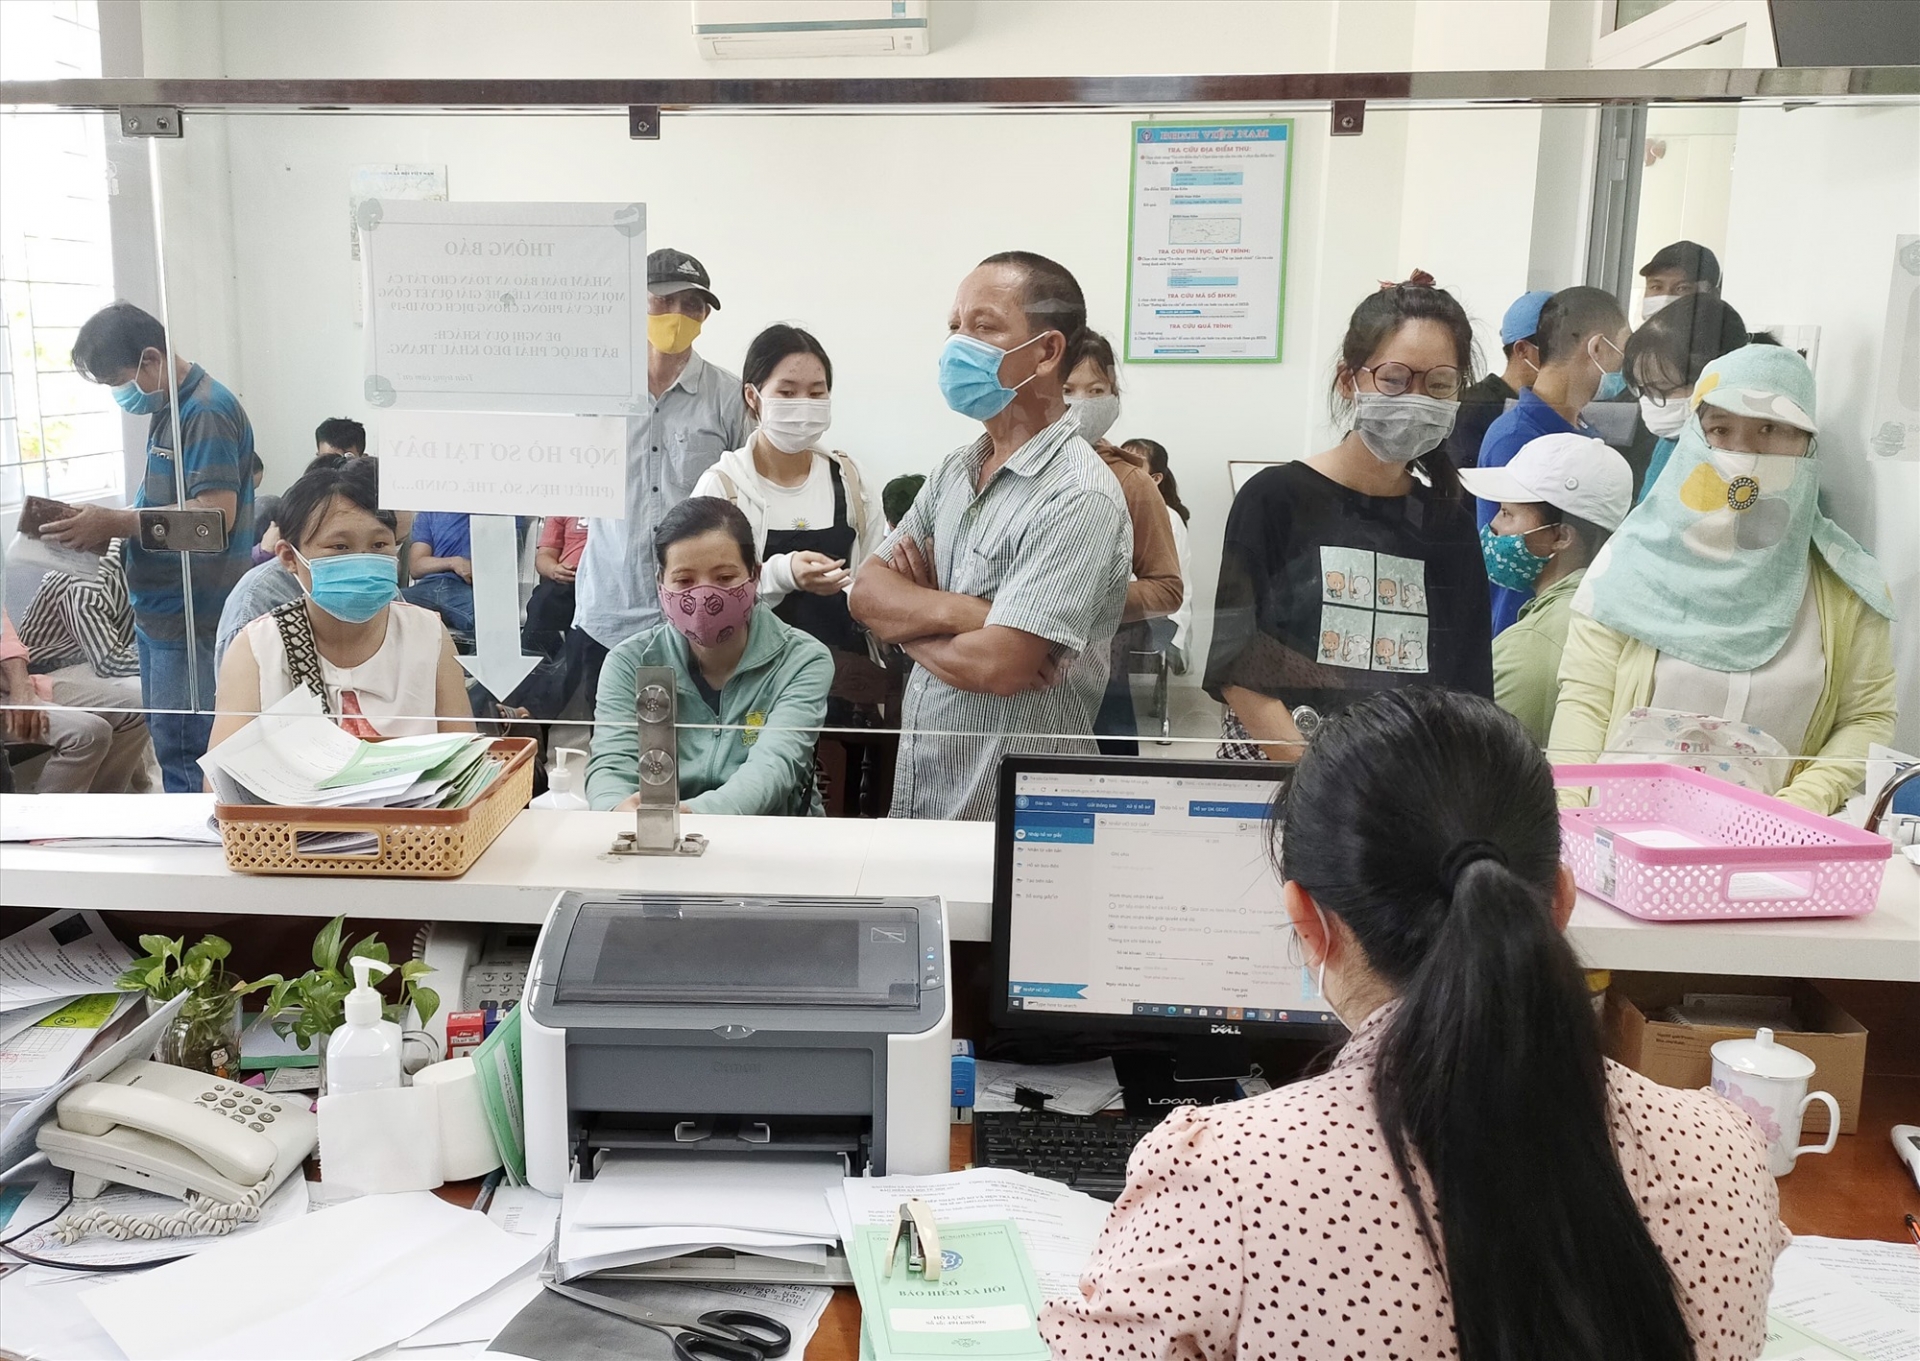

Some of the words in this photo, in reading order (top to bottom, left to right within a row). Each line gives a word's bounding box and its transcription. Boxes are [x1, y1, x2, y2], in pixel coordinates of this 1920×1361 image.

[1237, 128, 1269, 138] NAM
[1210, 1024, 1242, 1036] DELL
[1148, 1097, 1201, 1105] Loan
